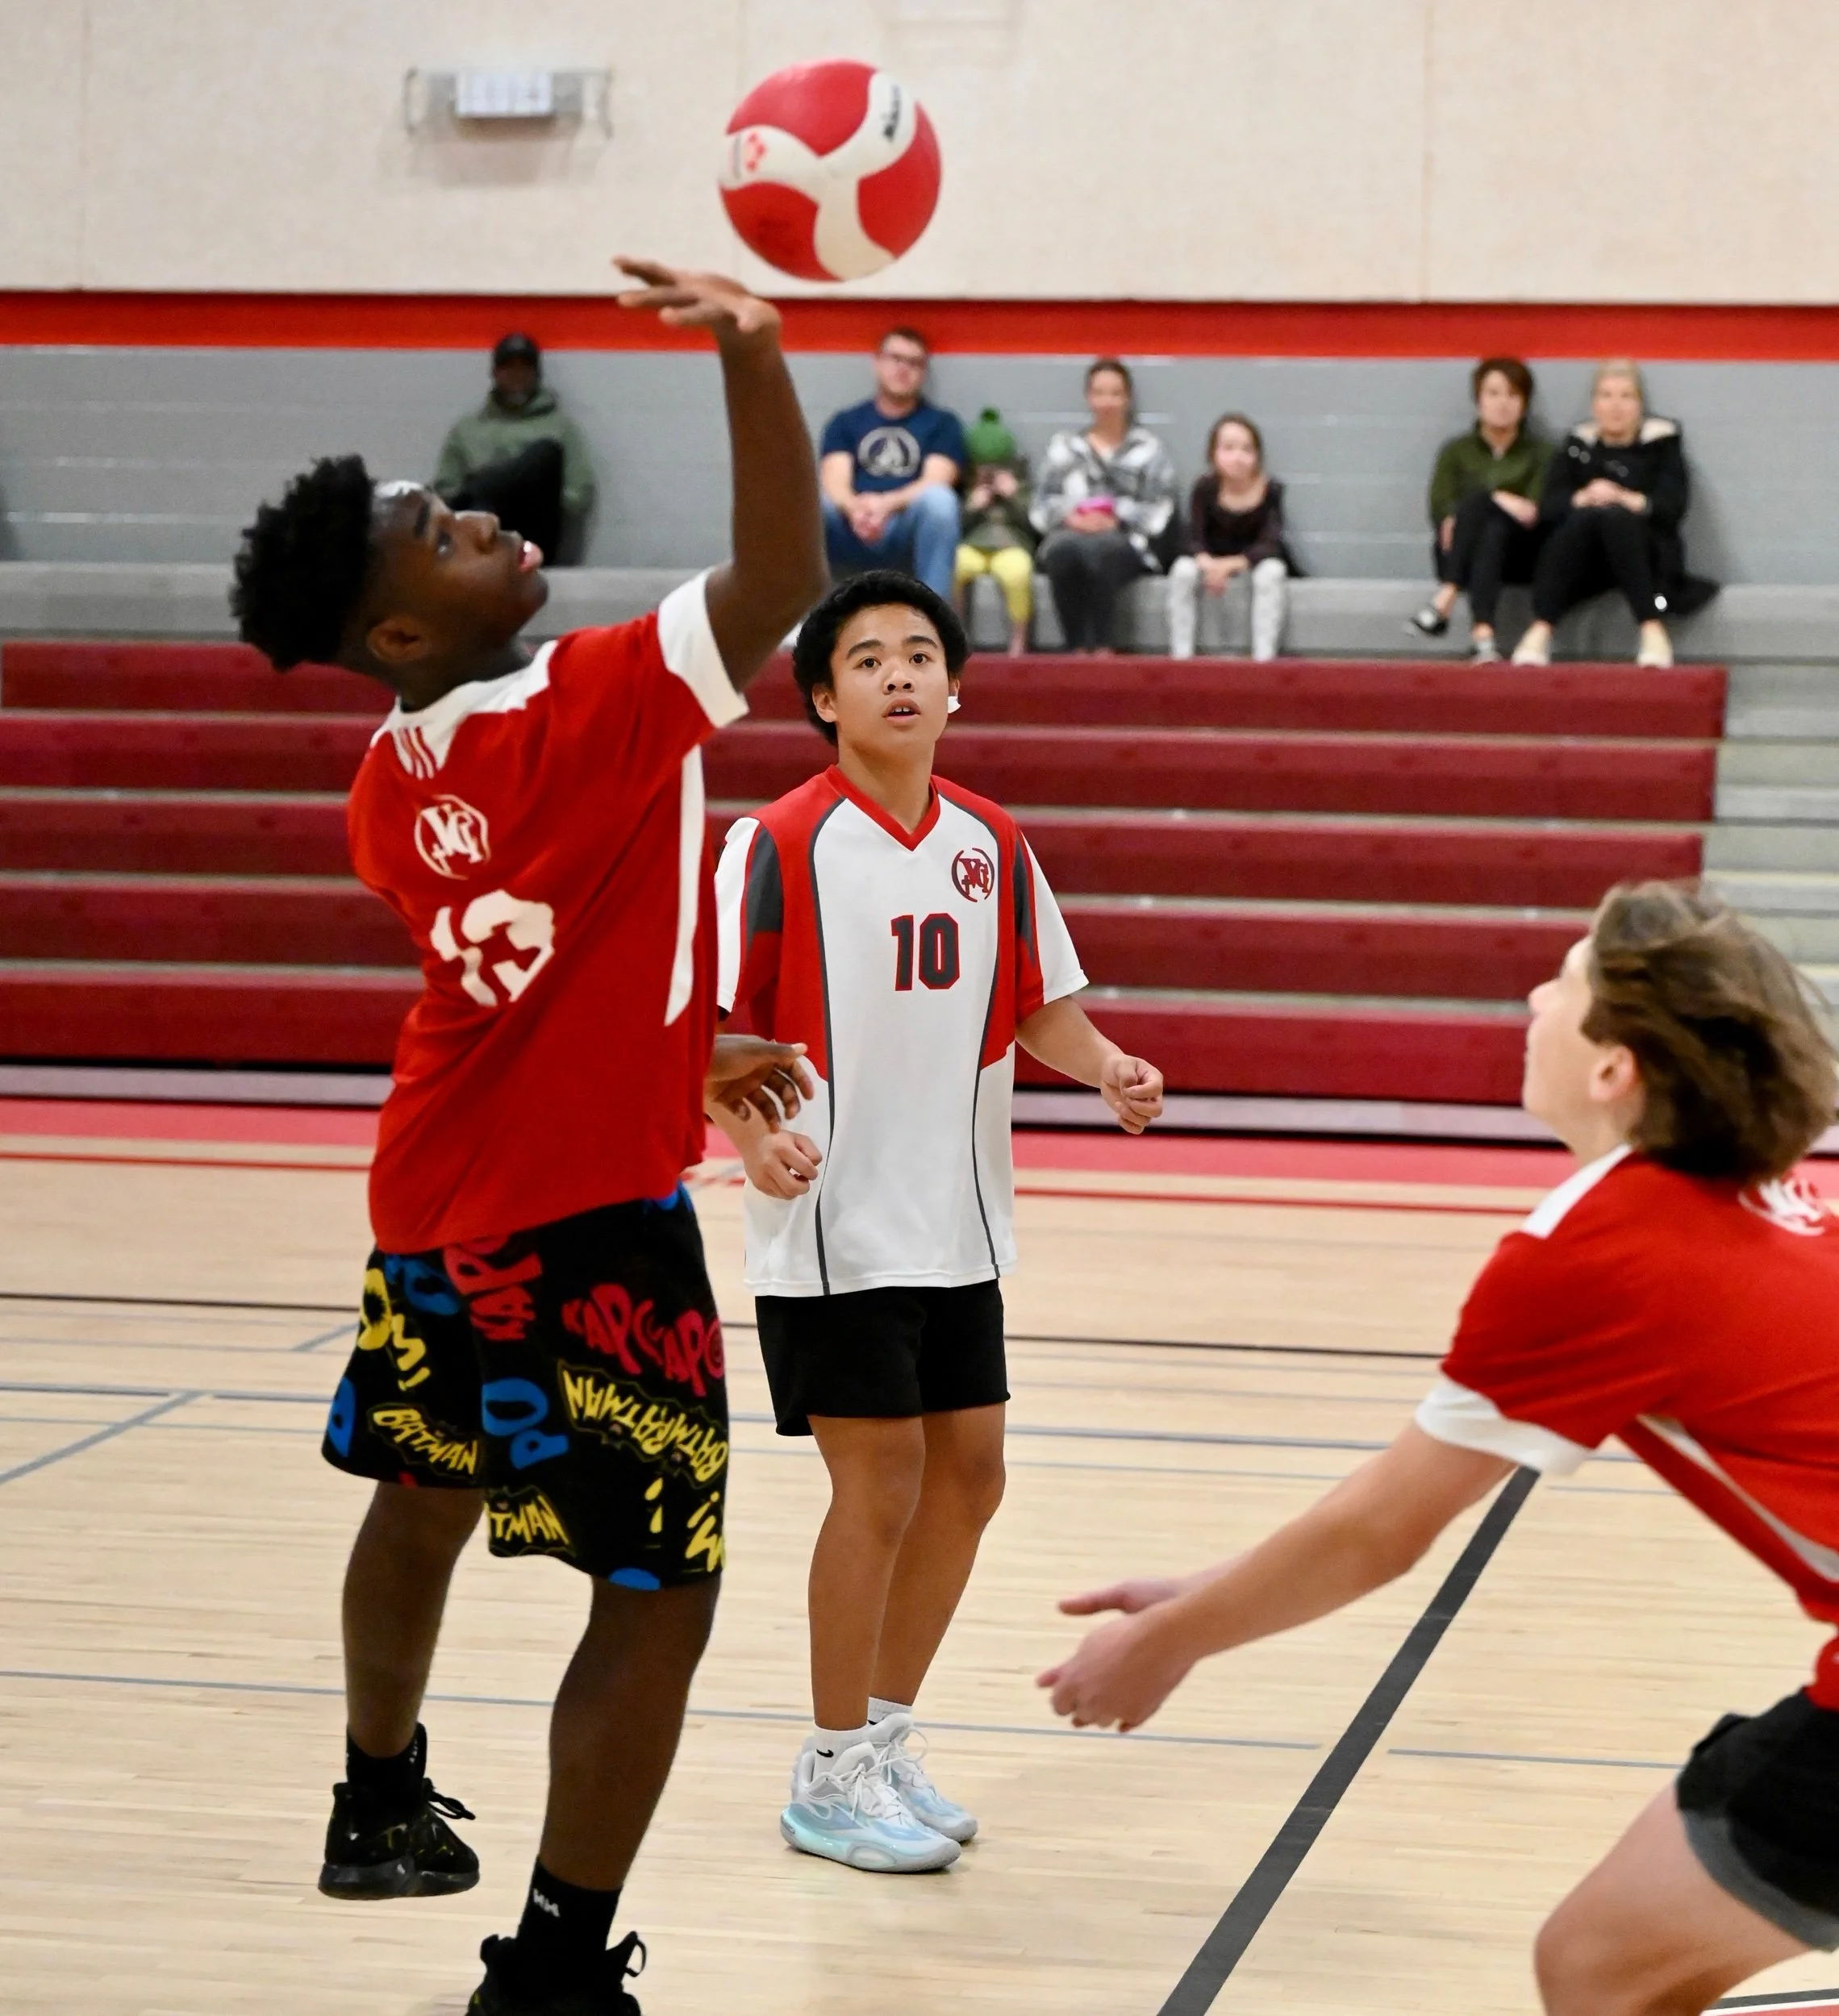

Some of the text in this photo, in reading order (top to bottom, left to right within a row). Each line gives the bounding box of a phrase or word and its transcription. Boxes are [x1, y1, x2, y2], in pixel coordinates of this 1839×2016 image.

[430, 889, 555, 1006] 13
[890, 913, 960, 991] 10
[372, 1409, 477, 1475] BATMAN
